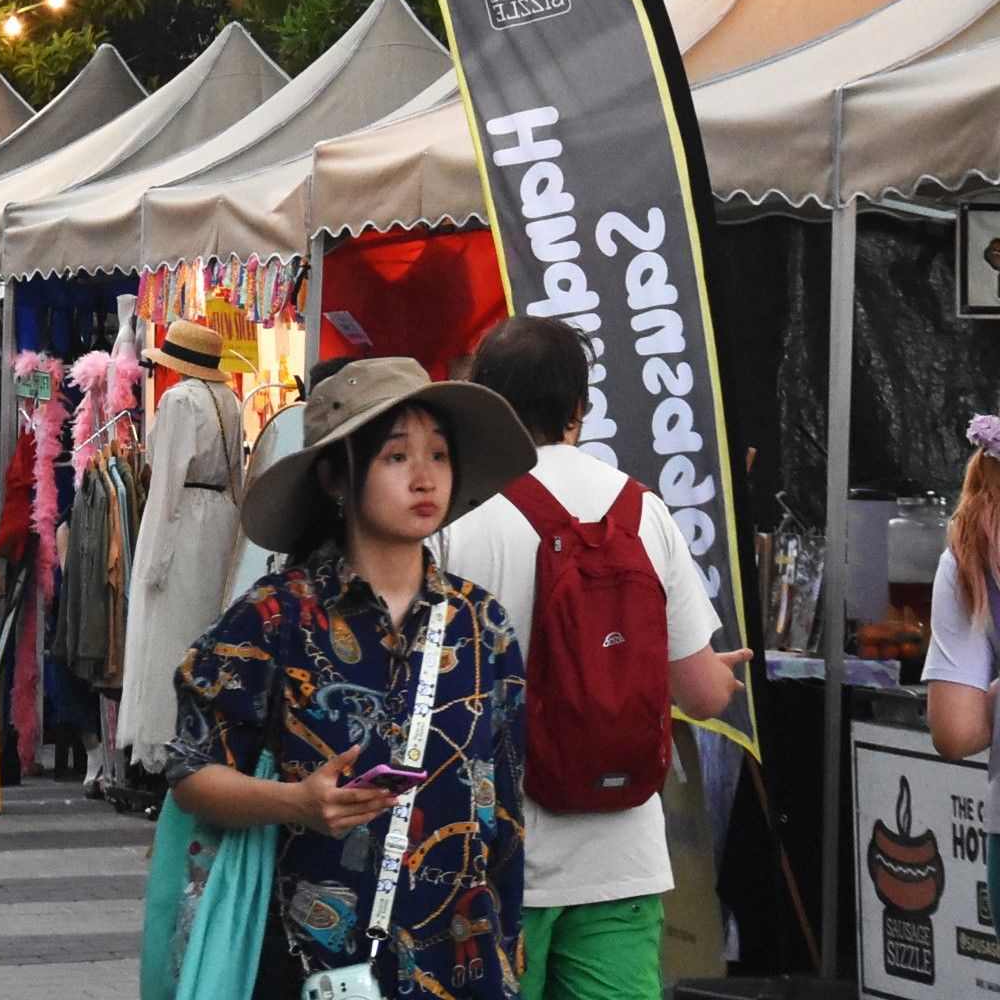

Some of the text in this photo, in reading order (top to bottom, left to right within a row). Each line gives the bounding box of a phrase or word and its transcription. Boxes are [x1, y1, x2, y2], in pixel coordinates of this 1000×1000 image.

[951, 794, 974, 821] THE
[952, 822, 988, 866] HOT
[886, 917, 931, 946] SAUSAGE
[886, 940, 932, 975] SIZZLE
